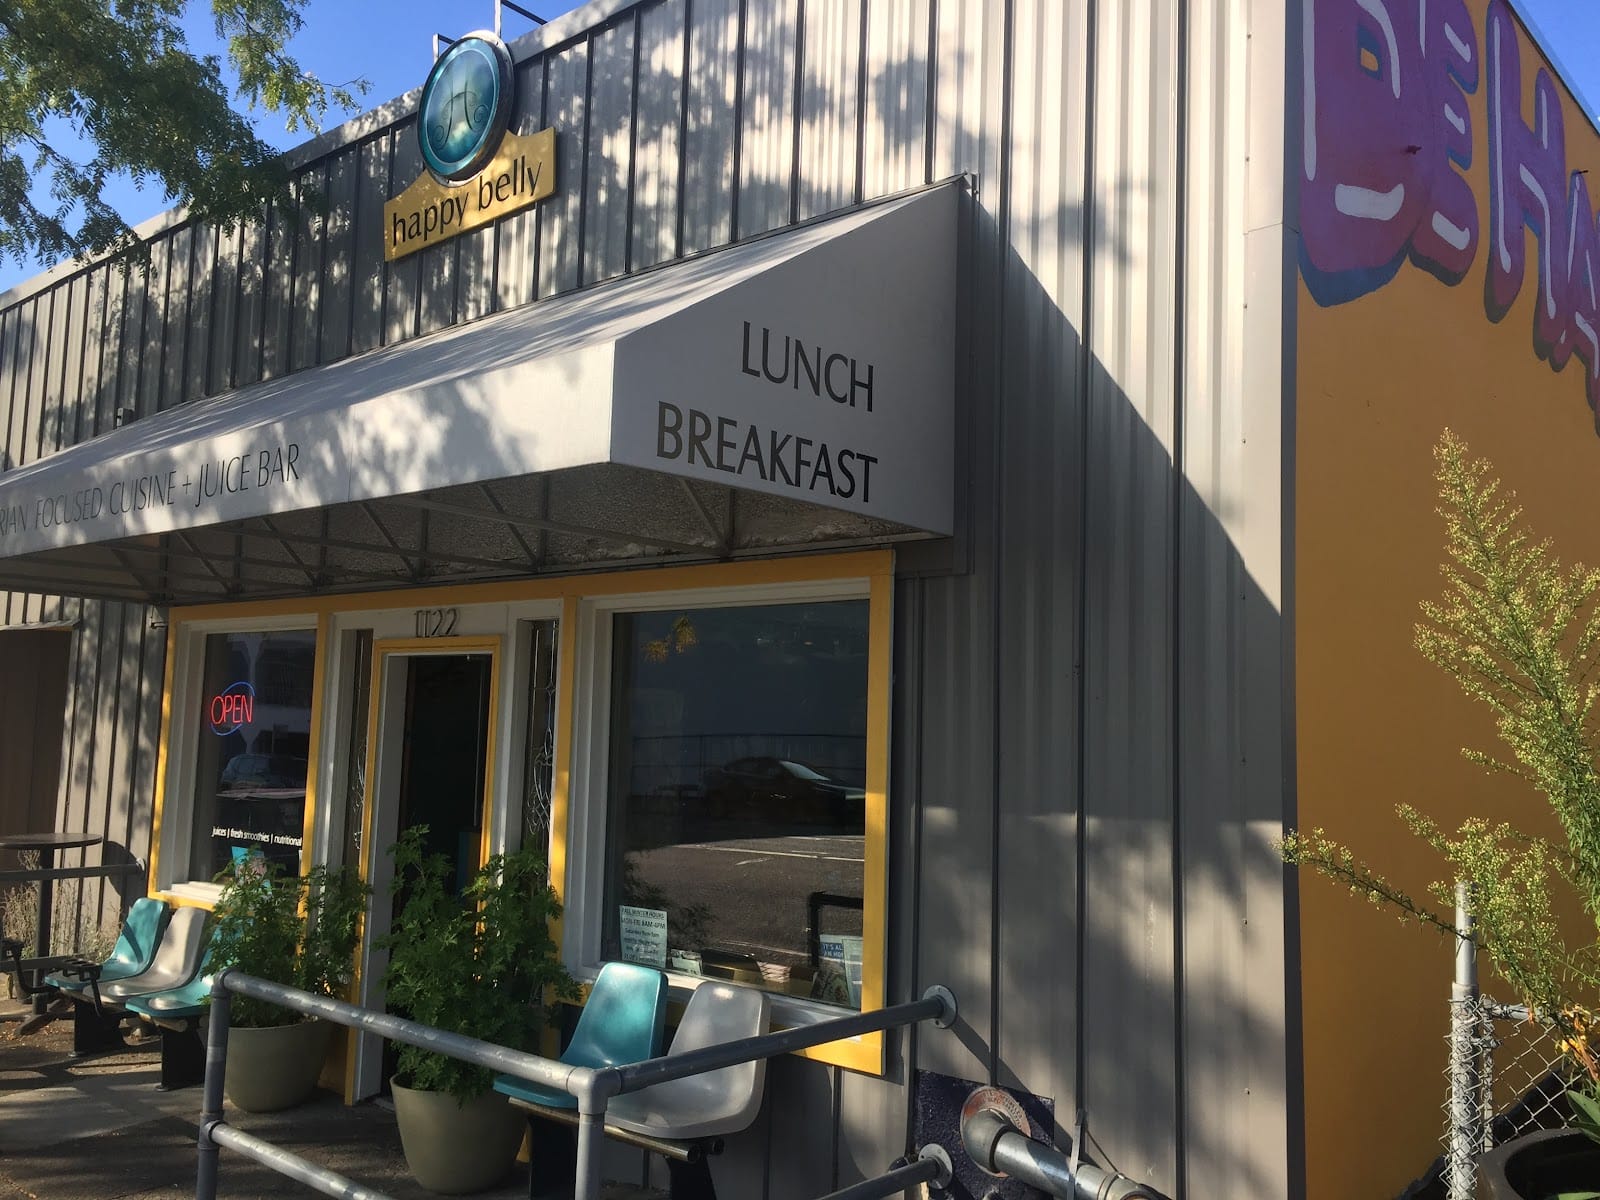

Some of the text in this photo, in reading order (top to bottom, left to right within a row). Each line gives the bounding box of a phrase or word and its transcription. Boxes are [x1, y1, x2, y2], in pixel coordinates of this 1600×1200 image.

[392, 154, 542, 247] happy belly
[741, 320, 874, 413] LUNCH
[35, 487, 103, 529] FOCUSED
[109, 470, 177, 516] CUISINE
[195, 453, 251, 508] JUICE
[257, 443, 300, 488] BAR
[656, 400, 878, 503] BREAKFAST
[413, 608, 460, 638] 1122
[210, 695, 254, 725] OPEN
[230, 828, 244, 839] fresh
[243, 831, 270, 843] smoothies
[273, 834, 302, 847] nutritional
